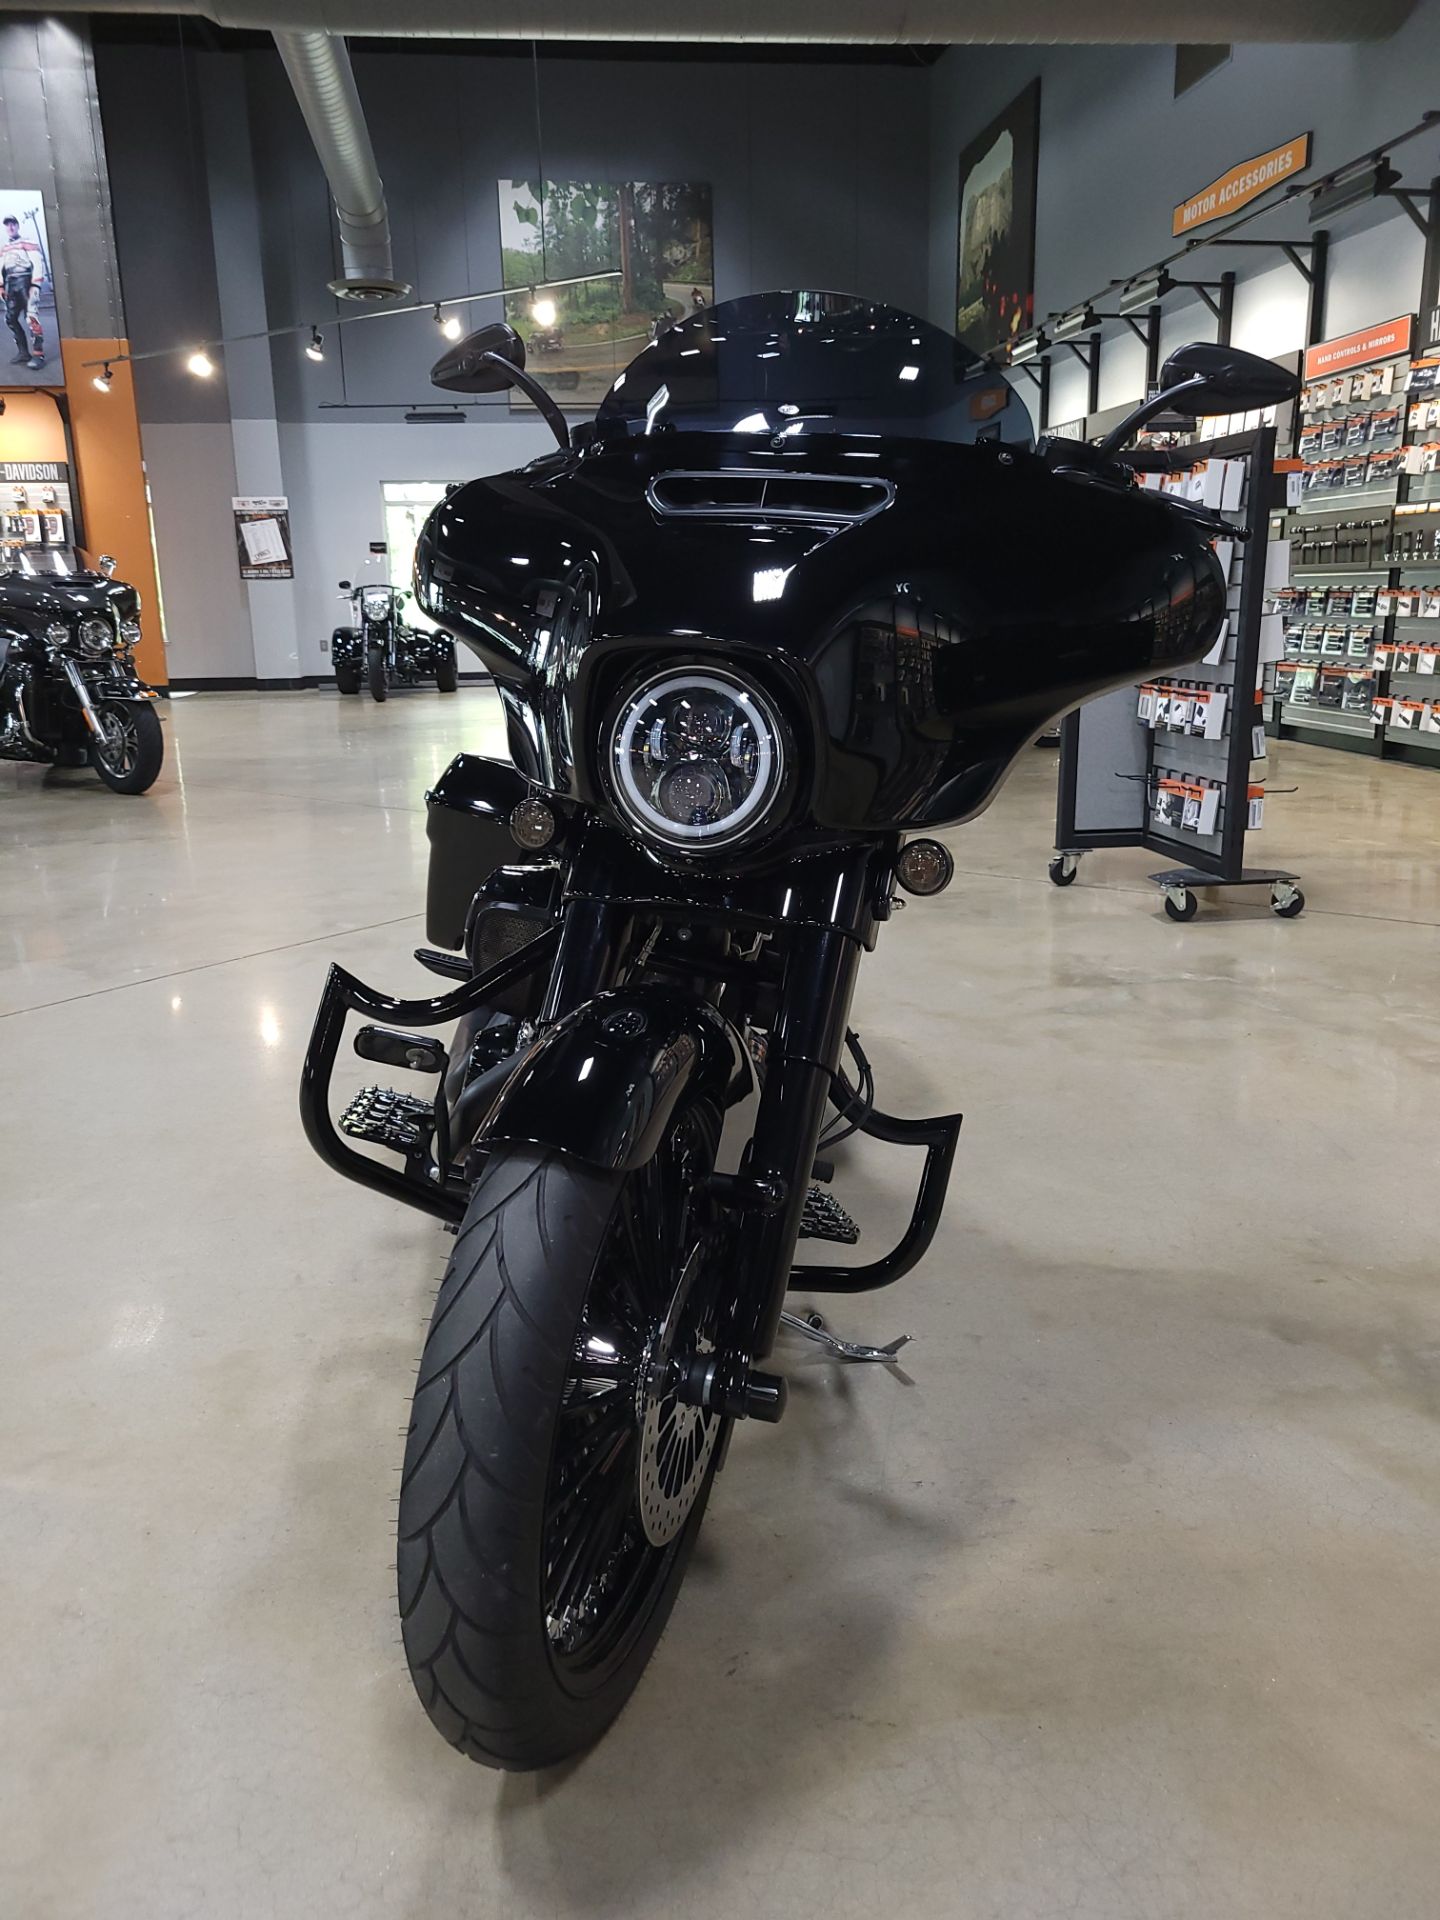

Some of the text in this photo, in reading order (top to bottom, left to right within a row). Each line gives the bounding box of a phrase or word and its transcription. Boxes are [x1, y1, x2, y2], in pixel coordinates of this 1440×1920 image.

[1183, 150, 1293, 225] MOTOR ACCESSORIES
[1317, 332, 1396, 365] HAND CONTROLS & MIRRORS
